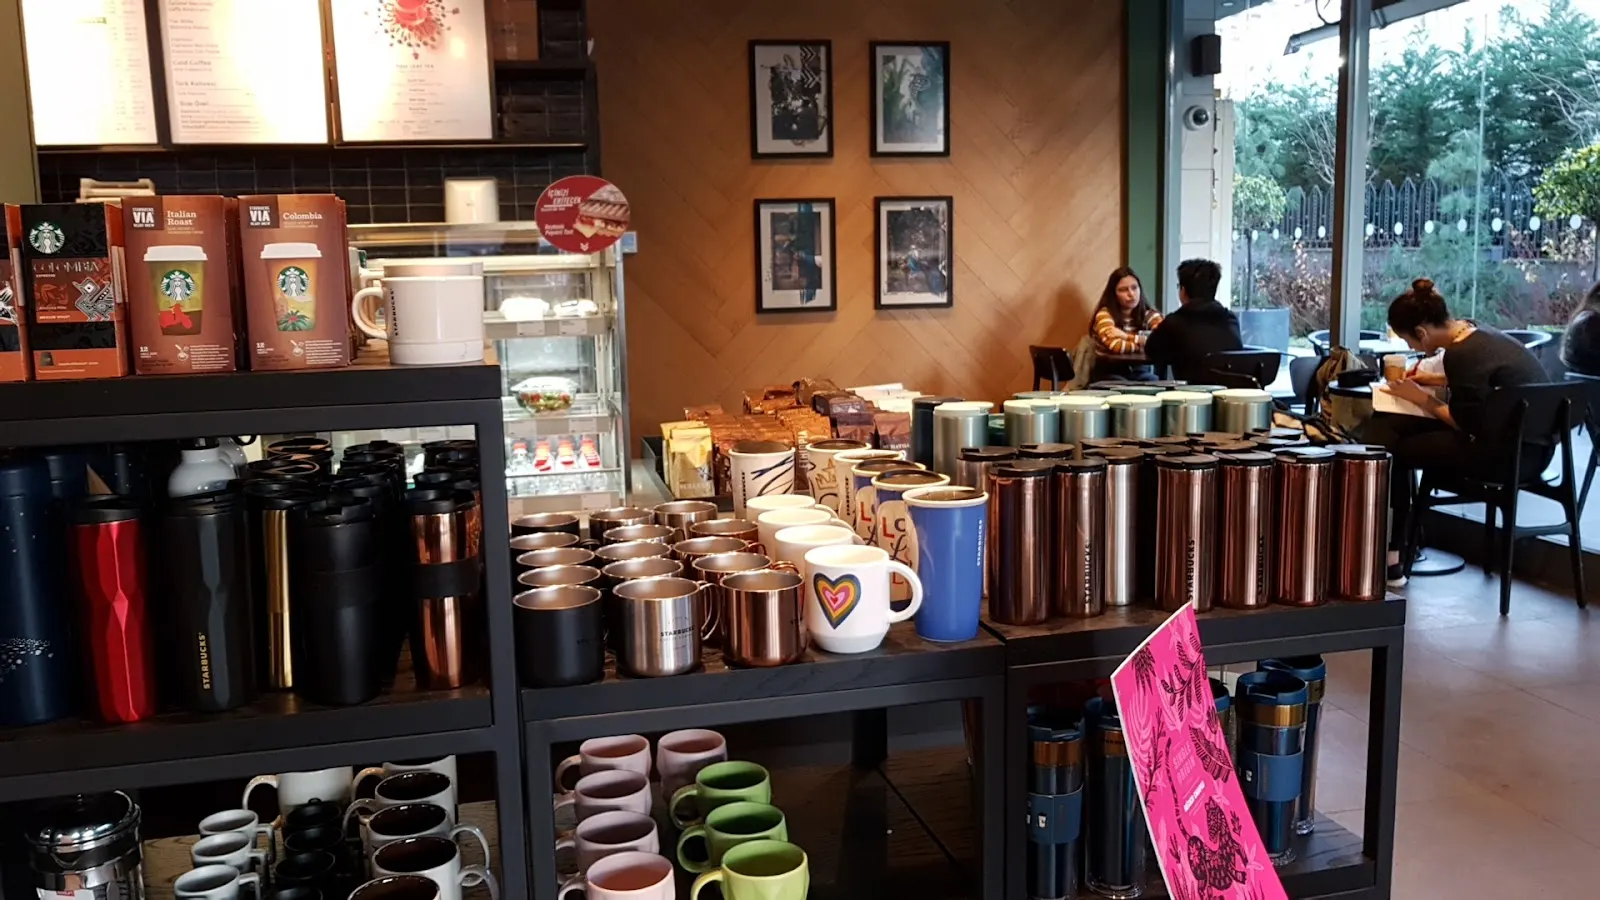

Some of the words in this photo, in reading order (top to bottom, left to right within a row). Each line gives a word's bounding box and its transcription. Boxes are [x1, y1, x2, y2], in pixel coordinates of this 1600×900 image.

[132, 212, 155, 223] VIA
[167, 210, 197, 218] Italian
[249, 210, 270, 222] VIA
[282, 212, 323, 220] Colombia
[33, 261, 99, 273] COLOMBIA
[390, 288, 398, 337] STARBUCKS
[798, 430, 808, 468] ETHIOPIA
[1084, 541, 1092, 604] STARBUCKS
[1187, 539, 1195, 601] STARBUCKS
[660, 626, 695, 638] STARBUCKS
[198, 632, 210, 690] STARBUCKS
